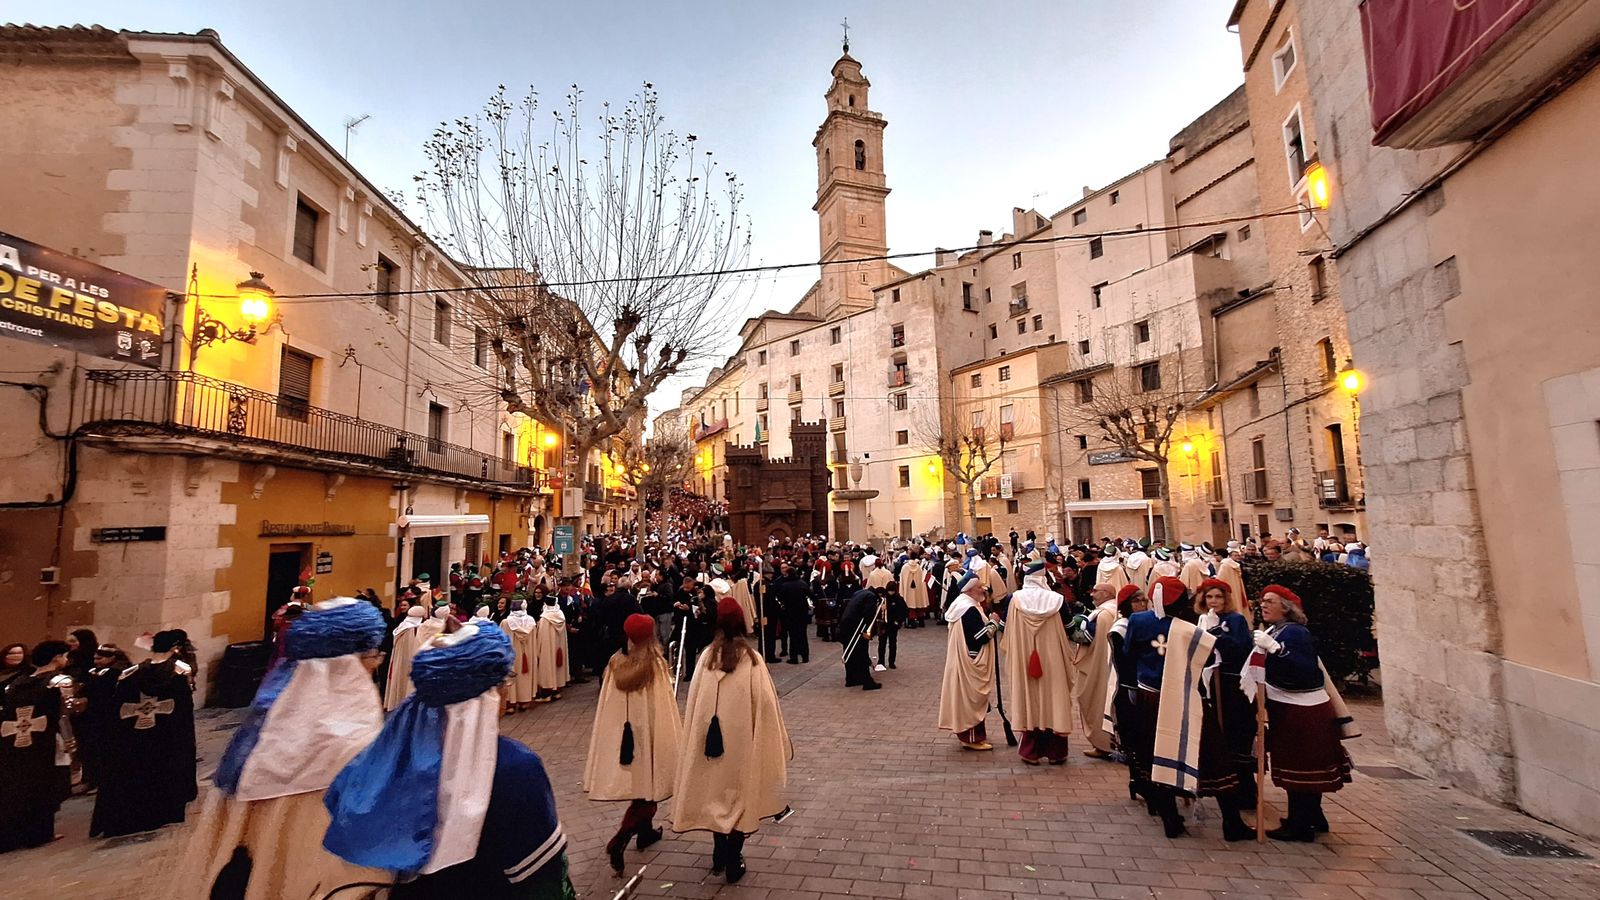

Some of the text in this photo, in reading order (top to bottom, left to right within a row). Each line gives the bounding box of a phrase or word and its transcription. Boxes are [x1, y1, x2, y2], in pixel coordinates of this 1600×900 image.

[27, 266, 62, 284] PER
[65, 278, 77, 289] A
[80, 282, 109, 298] LES
[1, 298, 94, 330] CRISTIANS
[50, 286, 161, 336] FESTA
